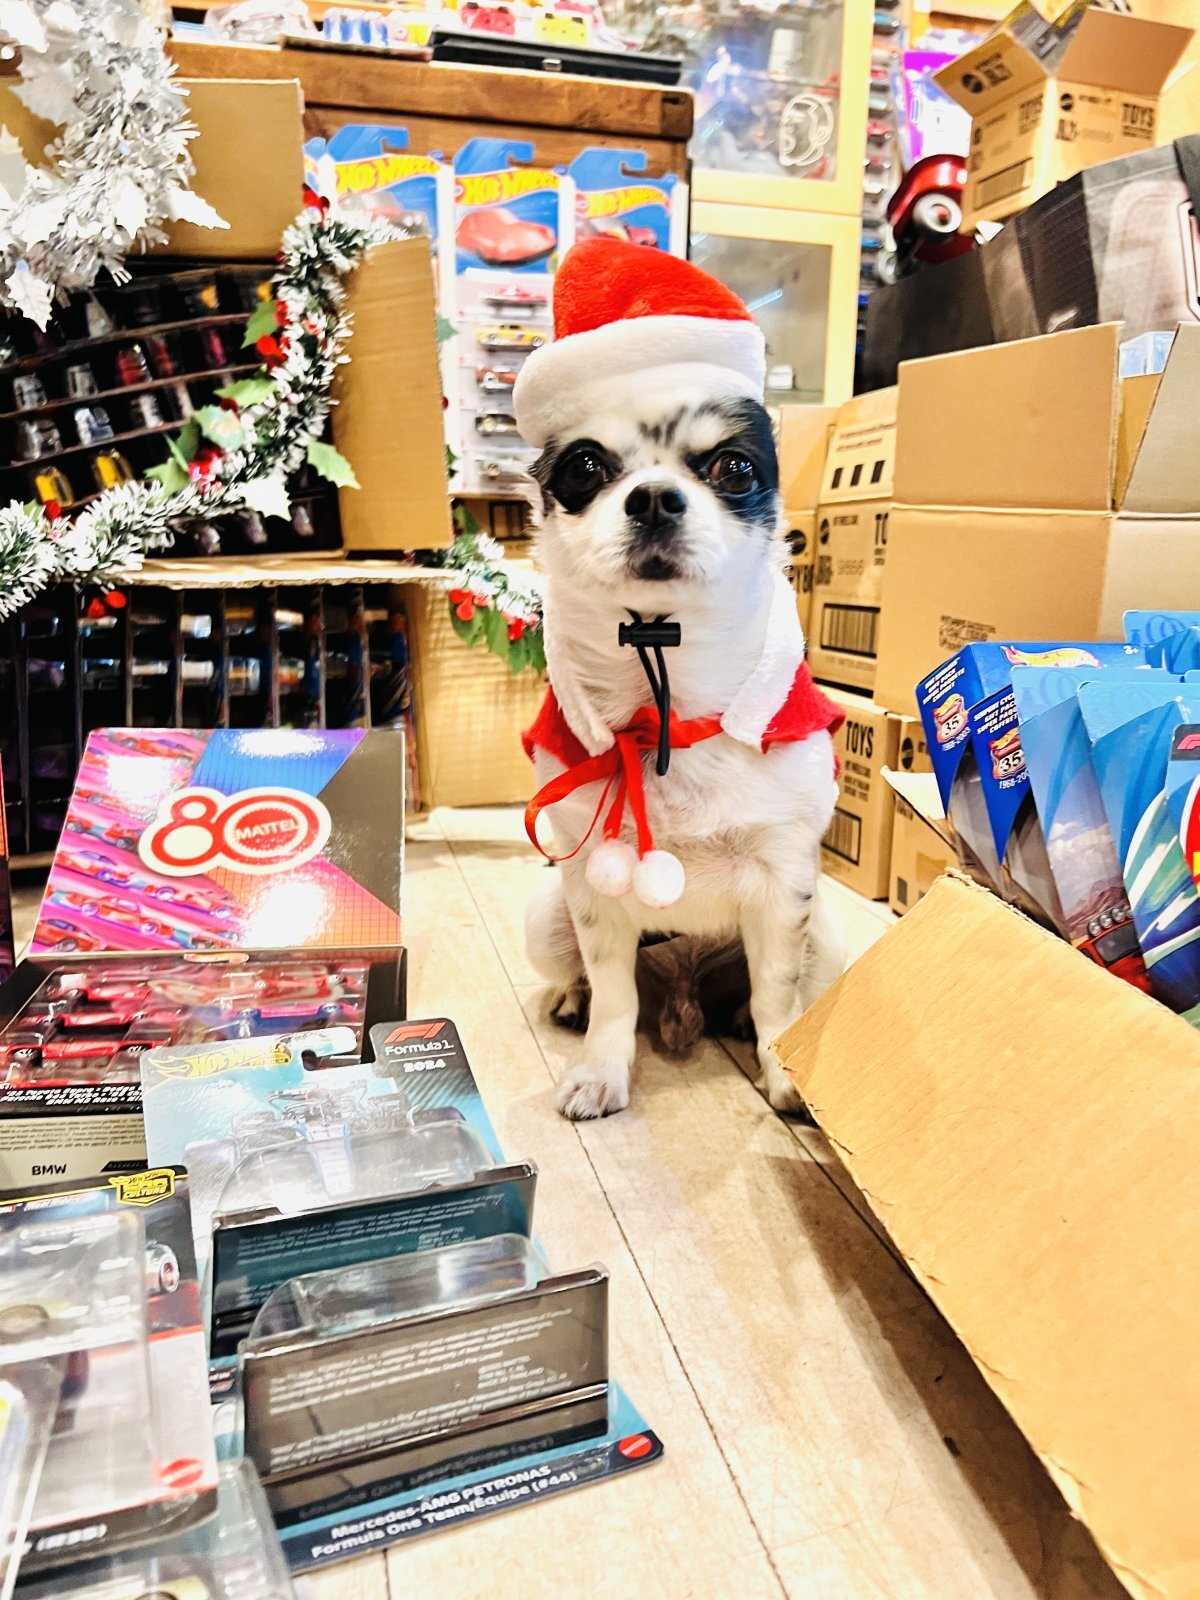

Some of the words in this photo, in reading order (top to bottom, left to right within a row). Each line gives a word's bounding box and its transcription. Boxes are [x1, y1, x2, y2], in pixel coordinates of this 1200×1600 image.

[1122, 102, 1154, 127] TOYS
[461, 176, 500, 205] HOT
[945, 715, 959, 735] 35
[845, 720, 874, 760] TOYS
[1001, 751, 1022, 772] 35
[234, 818, 298, 840] MATTEL
[403, 1059, 446, 1072] 2024
[31, 1163, 68, 1176] BMW
[123, 1187, 167, 1199] CULTURE
[331, 1491, 461, 1539] Mercedes-AMG
[461, 1465, 551, 1499] PETRONAS
[311, 1529, 386, 1558] Formula
[386, 1518, 422, 1535] One
[423, 1485, 530, 1523] Team/Équipe
